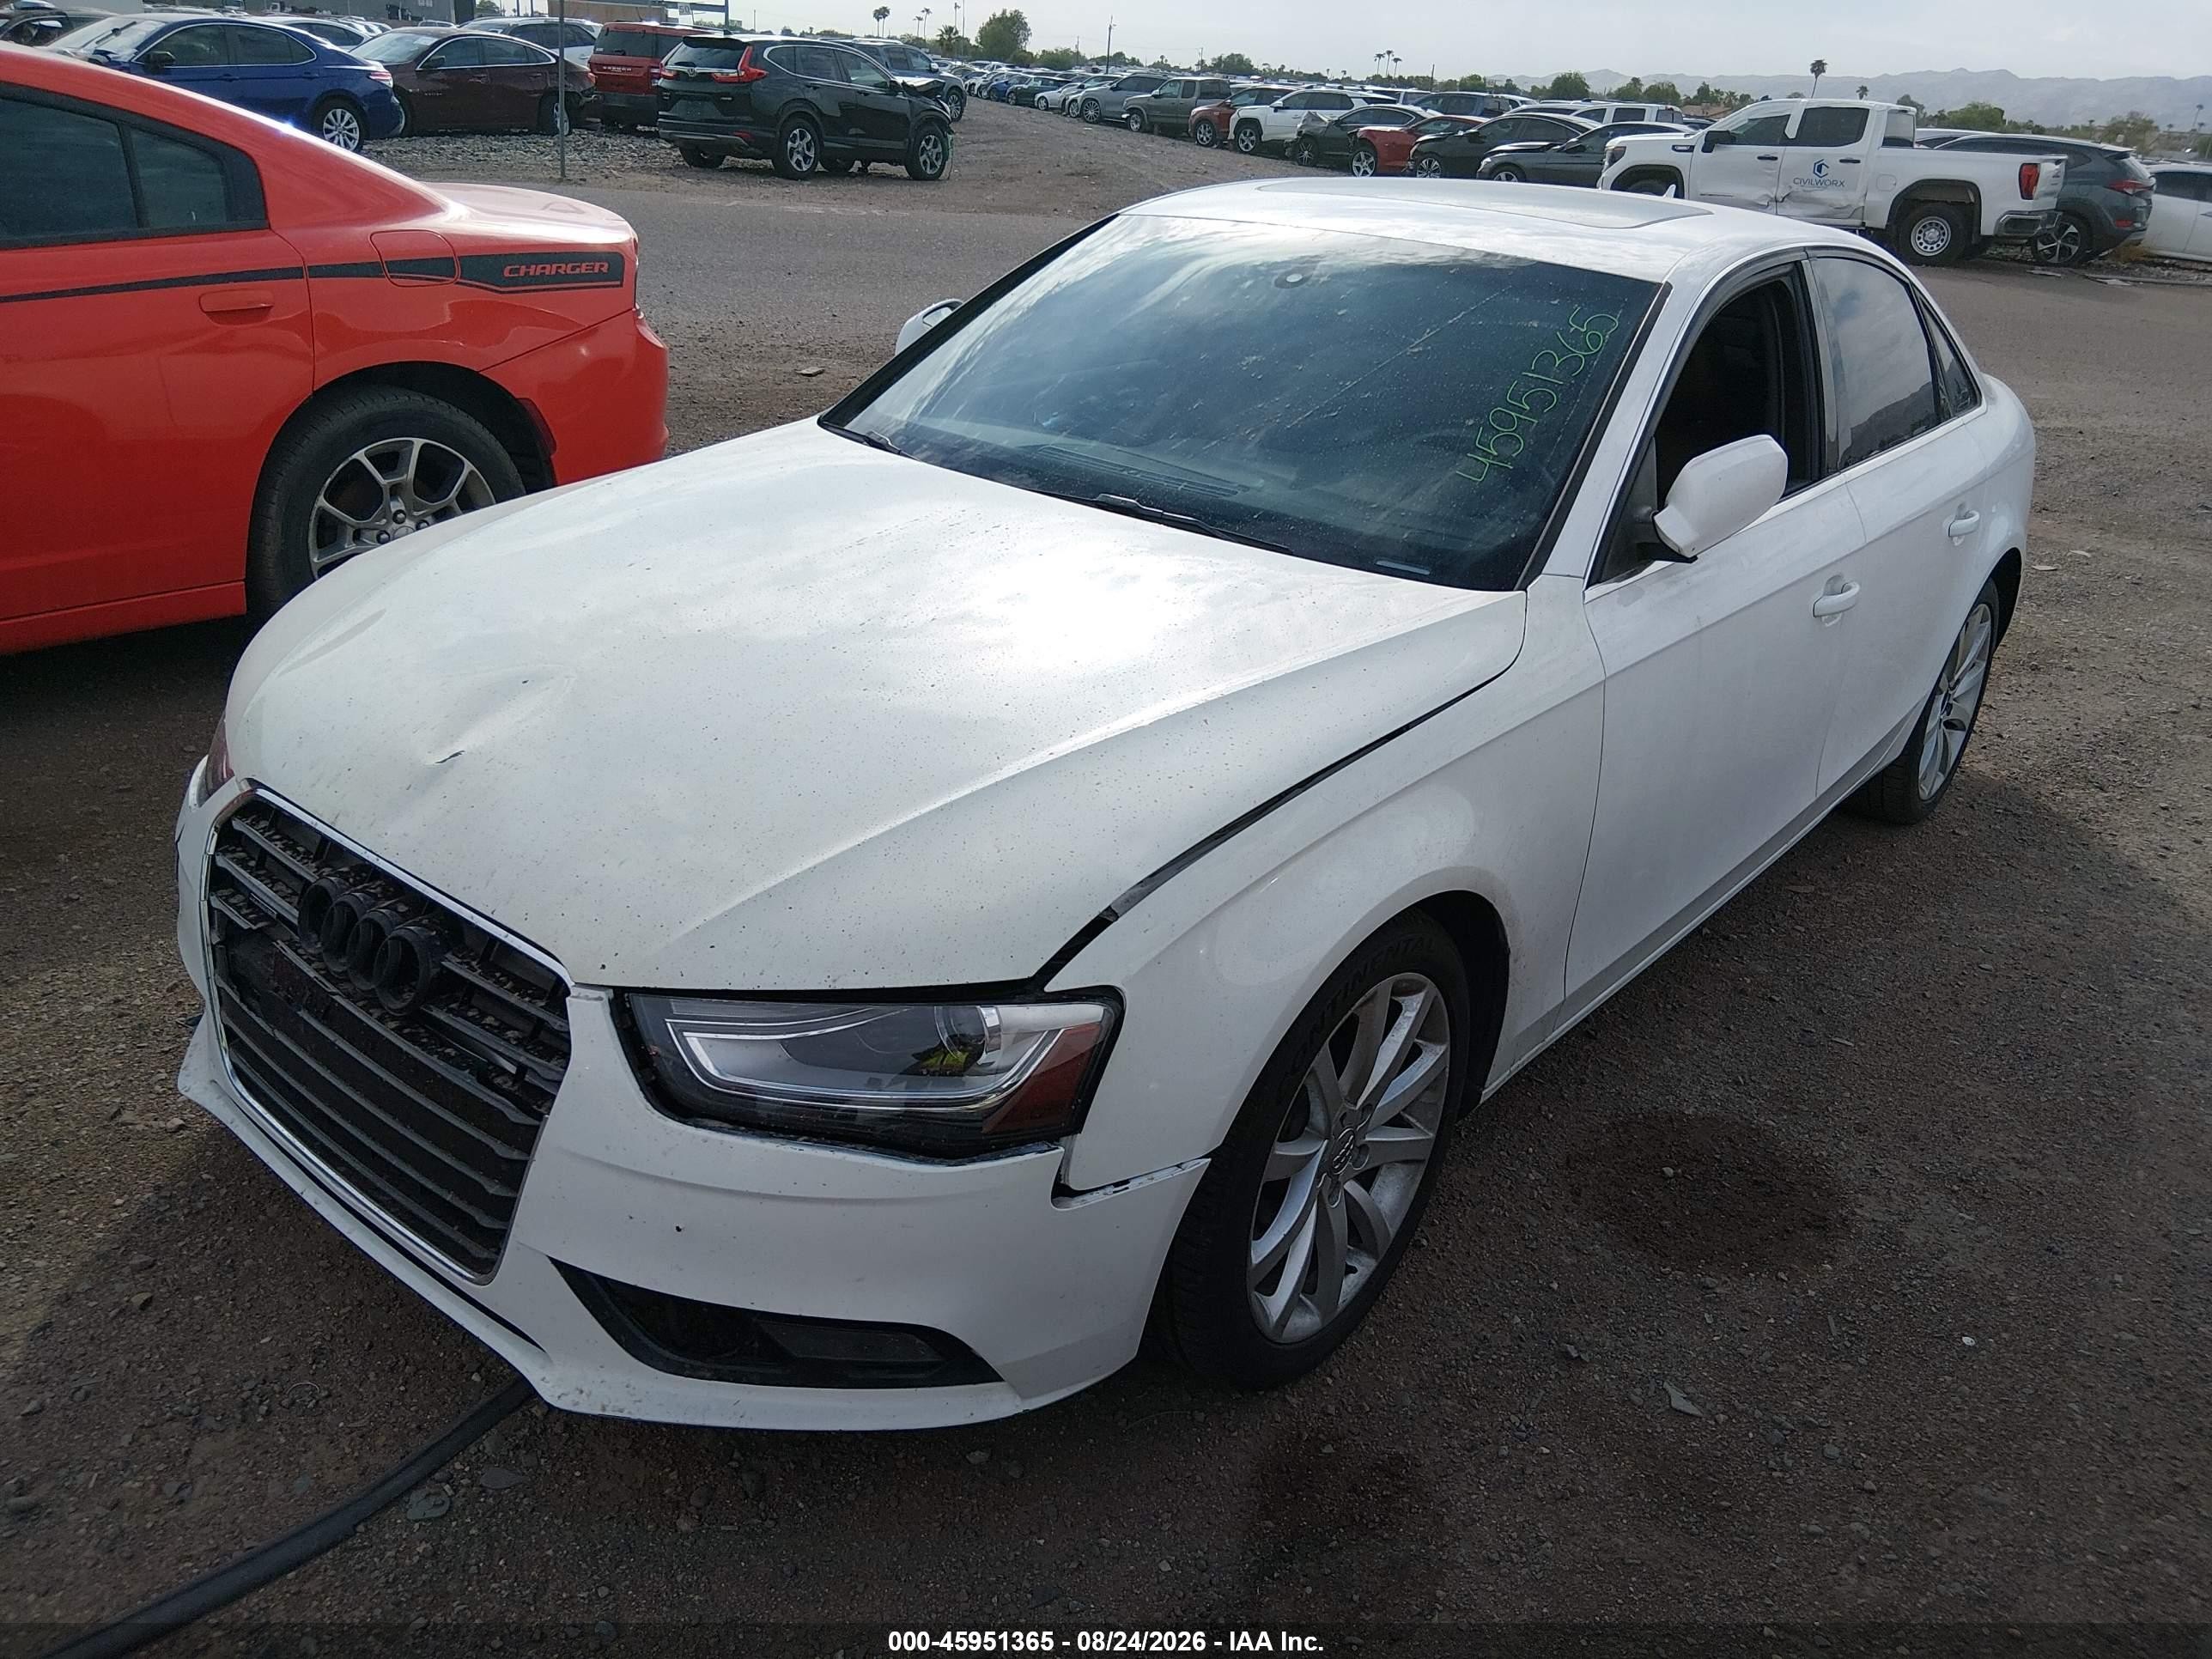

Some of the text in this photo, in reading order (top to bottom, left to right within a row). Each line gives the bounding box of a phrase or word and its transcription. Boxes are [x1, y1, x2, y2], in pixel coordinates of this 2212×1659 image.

[1792, 177, 1845, 187] CIVILWORX
[503, 261, 609, 277] CHARGER
[1455, 306, 1620, 482] 45951365
